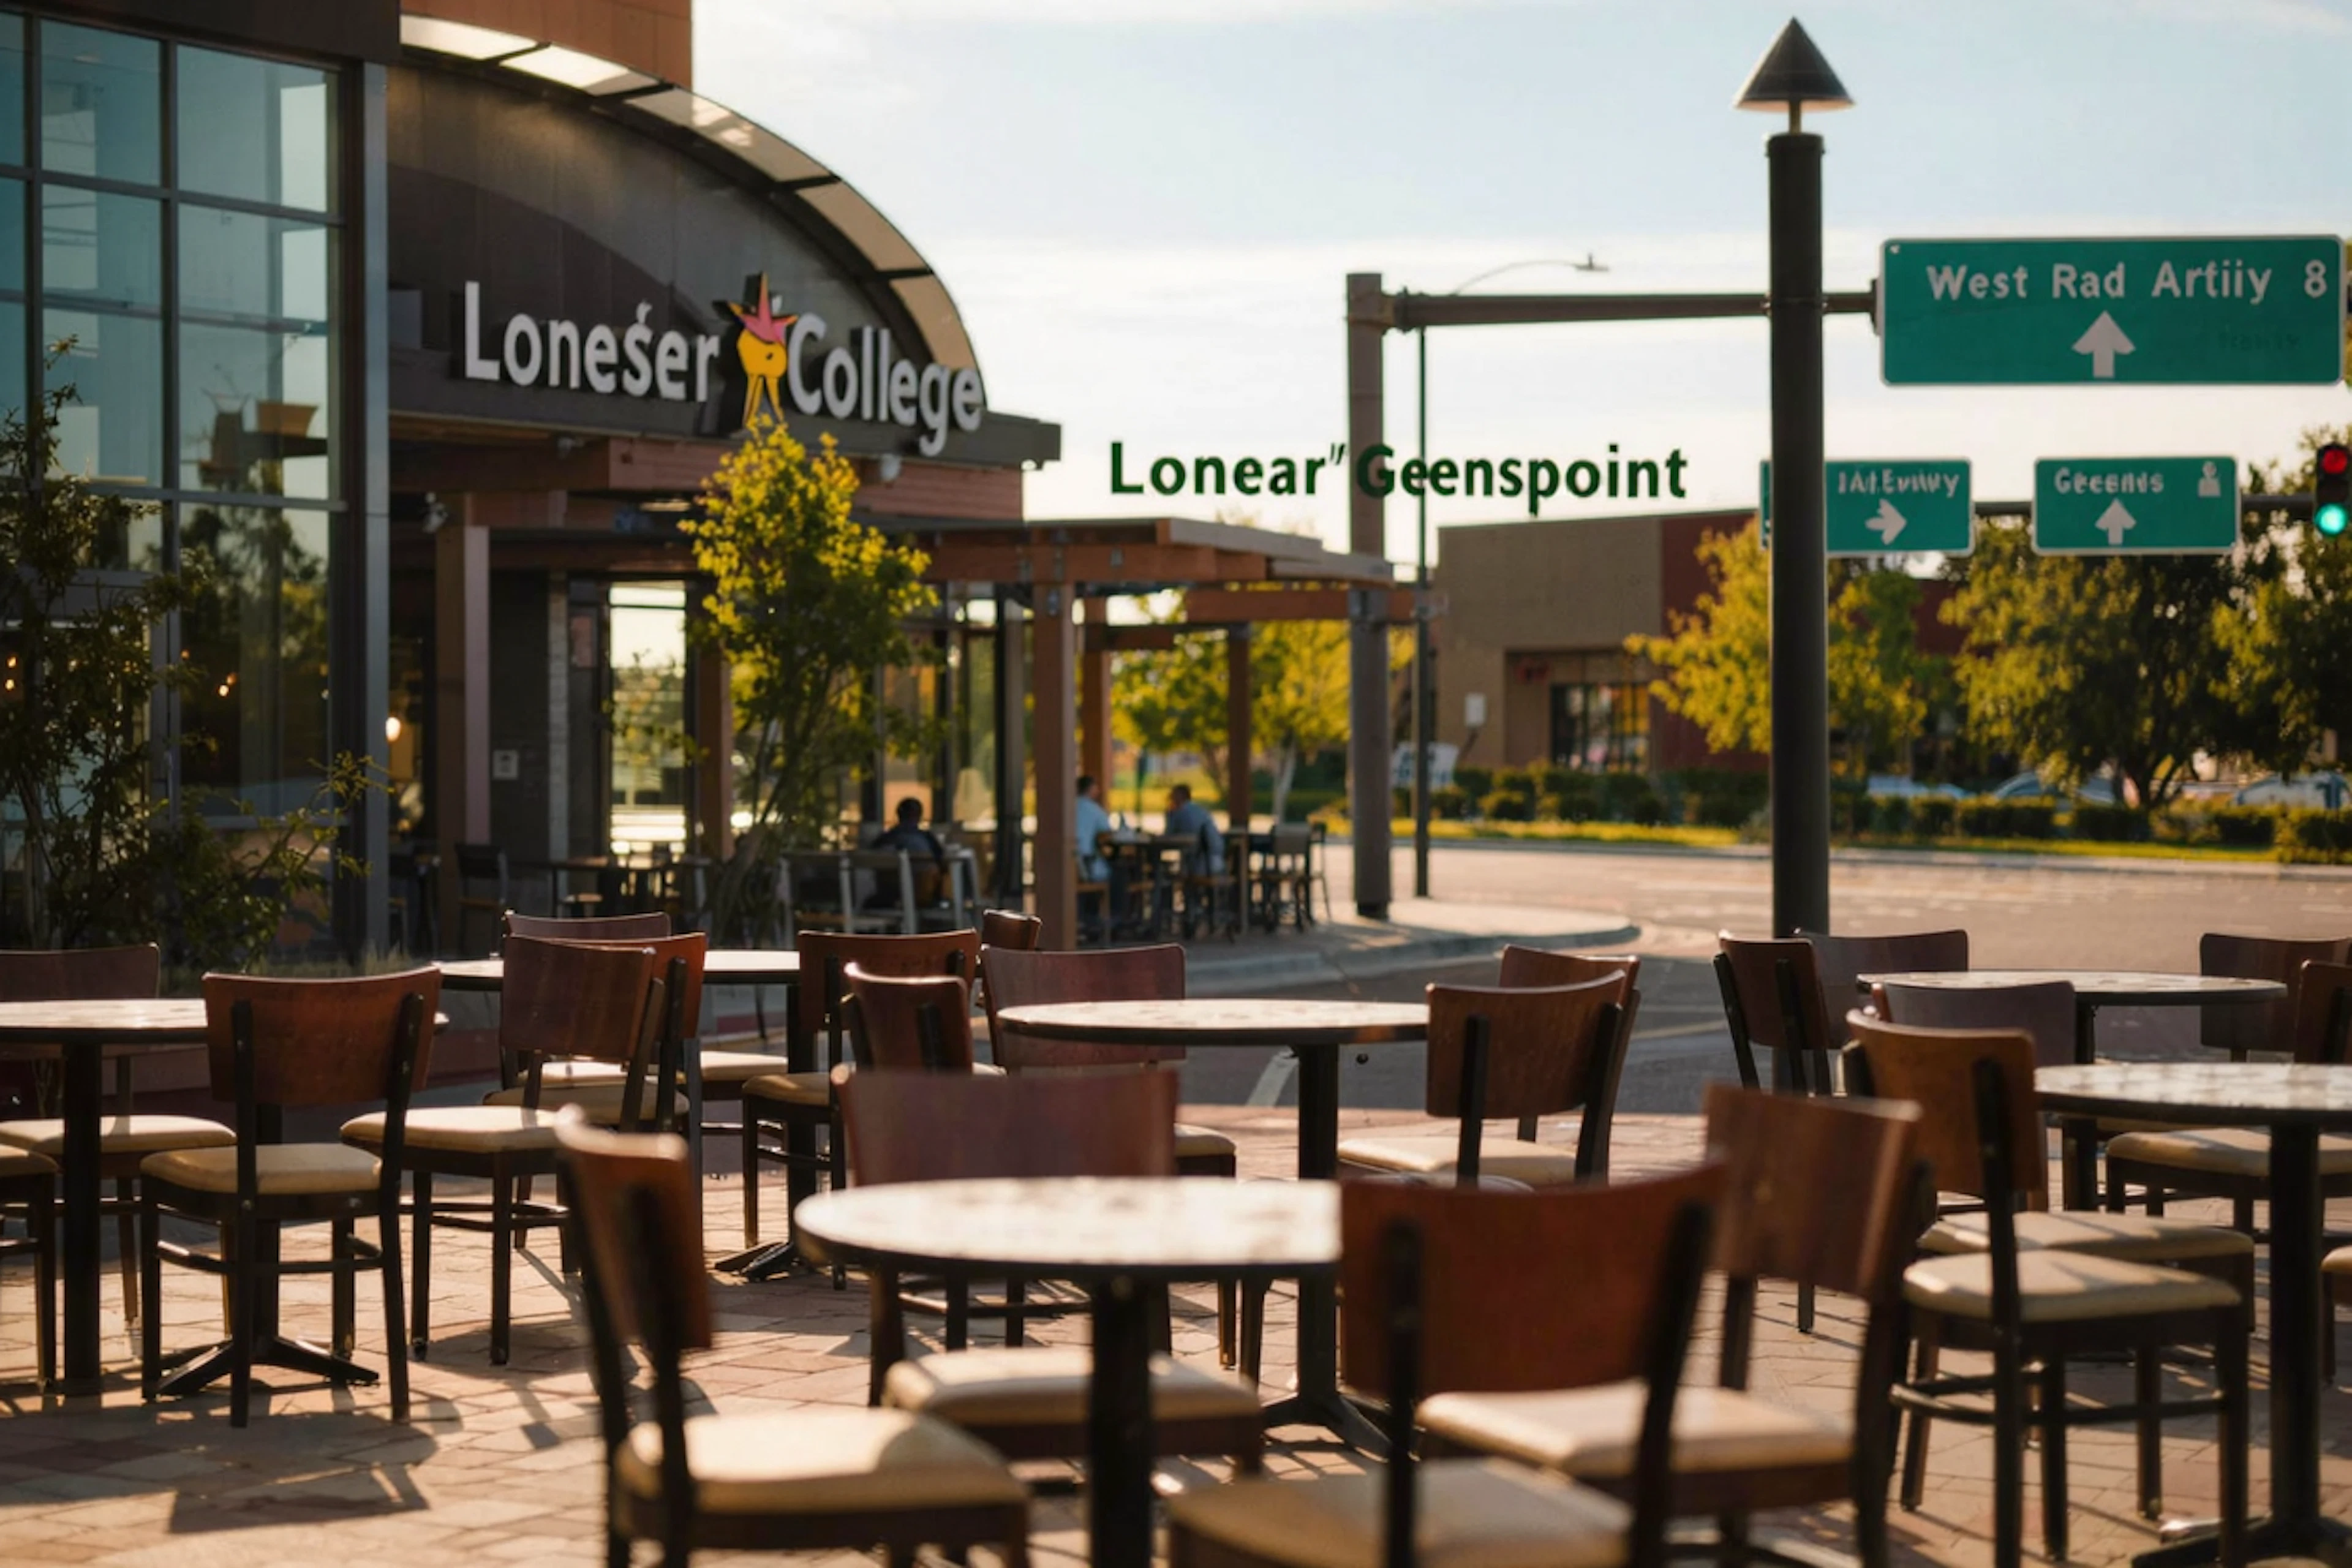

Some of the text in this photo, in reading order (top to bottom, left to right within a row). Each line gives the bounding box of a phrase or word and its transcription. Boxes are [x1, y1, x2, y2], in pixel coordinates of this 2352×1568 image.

[1926, 265, 2029, 300] West
[2052, 262, 2125, 299] Rad
[2304, 259, 2328, 298] 8
[788, 313, 982, 456] College
